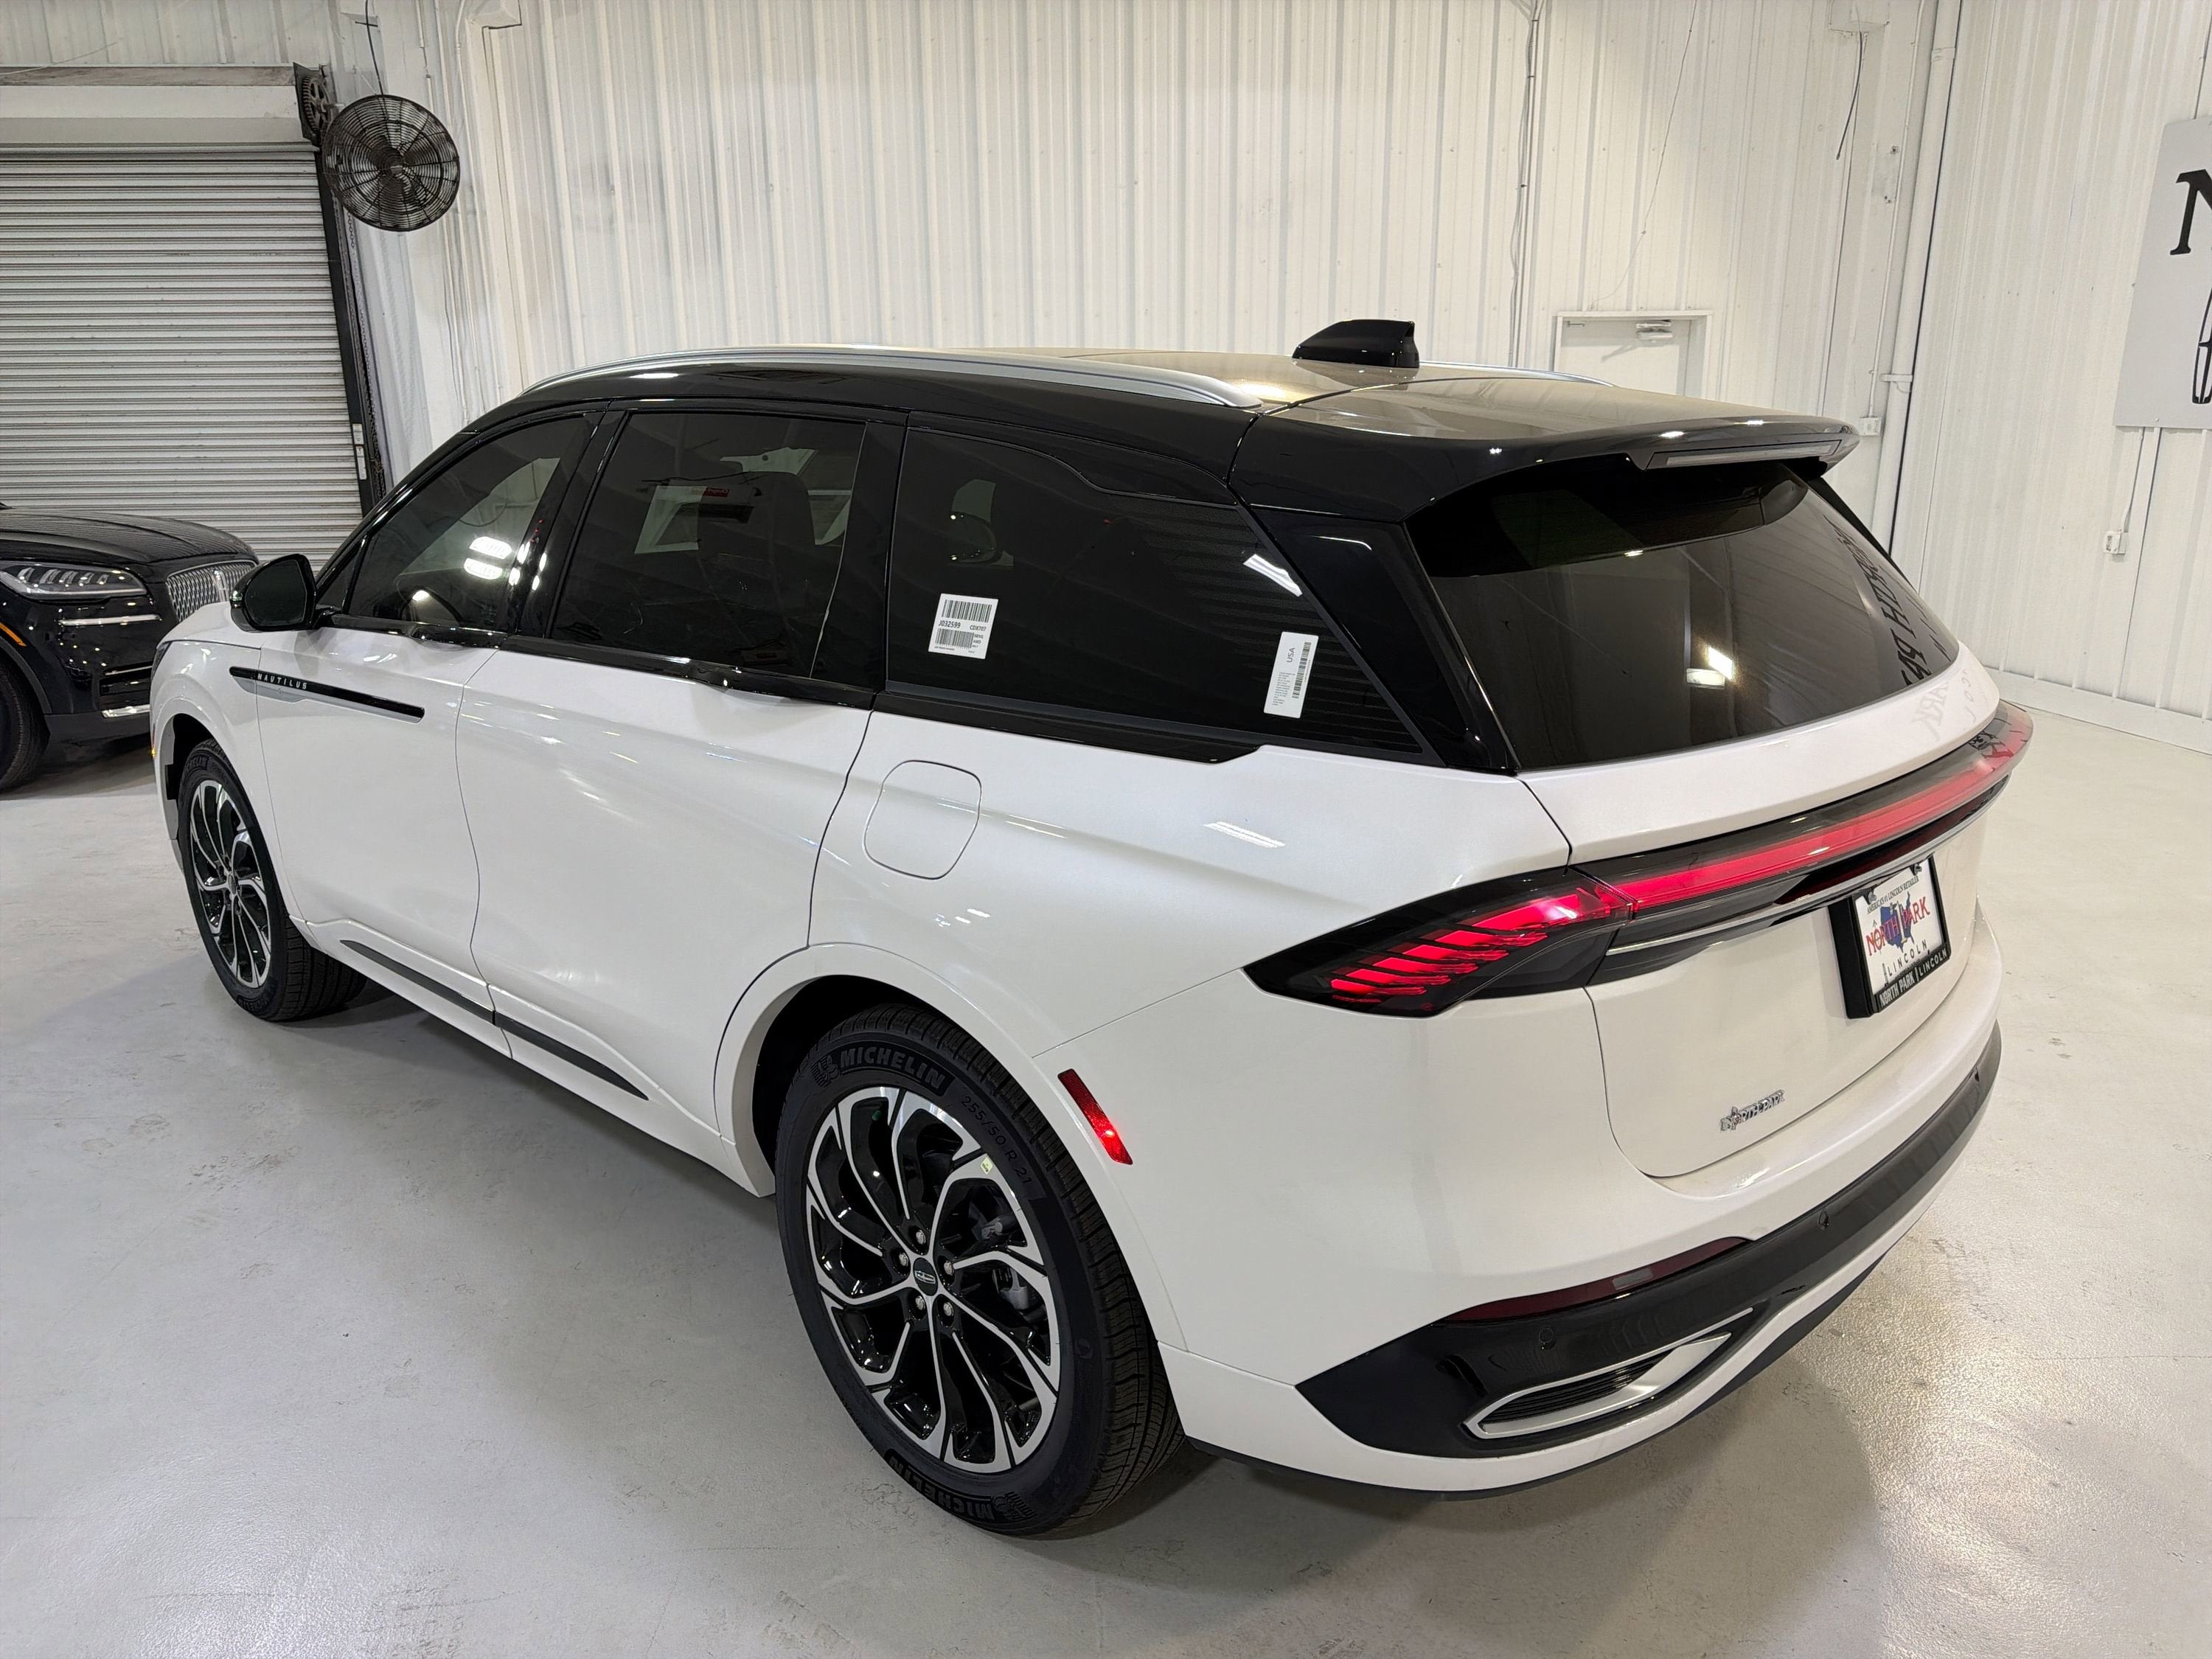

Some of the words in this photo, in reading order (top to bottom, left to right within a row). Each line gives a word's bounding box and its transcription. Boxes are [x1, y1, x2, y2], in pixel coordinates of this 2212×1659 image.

[939, 620, 961, 628] J032599
[1286, 647, 1295, 663] USA
[257, 672, 307, 689] NAUTILUS
[1888, 884, 1904, 900] LINCOLN
[1865, 915, 1899, 956] NORTH
[1902, 896, 1930, 928] PARK
[1879, 983, 1900, 1008] NORTH
[1899, 970, 1916, 992] PARK
[1919, 947, 1947, 977] LINCOLN
[1888, 939, 1927, 976] LINCOLN
[841, 1046, 946, 1089] MICHELIN
[961, 1096, 1006, 1145] 255/50
[1004, 1149, 1018, 1161] R
[1014, 1166, 1032, 1183] 21
[888, 1456, 995, 1520] MICHELIN
